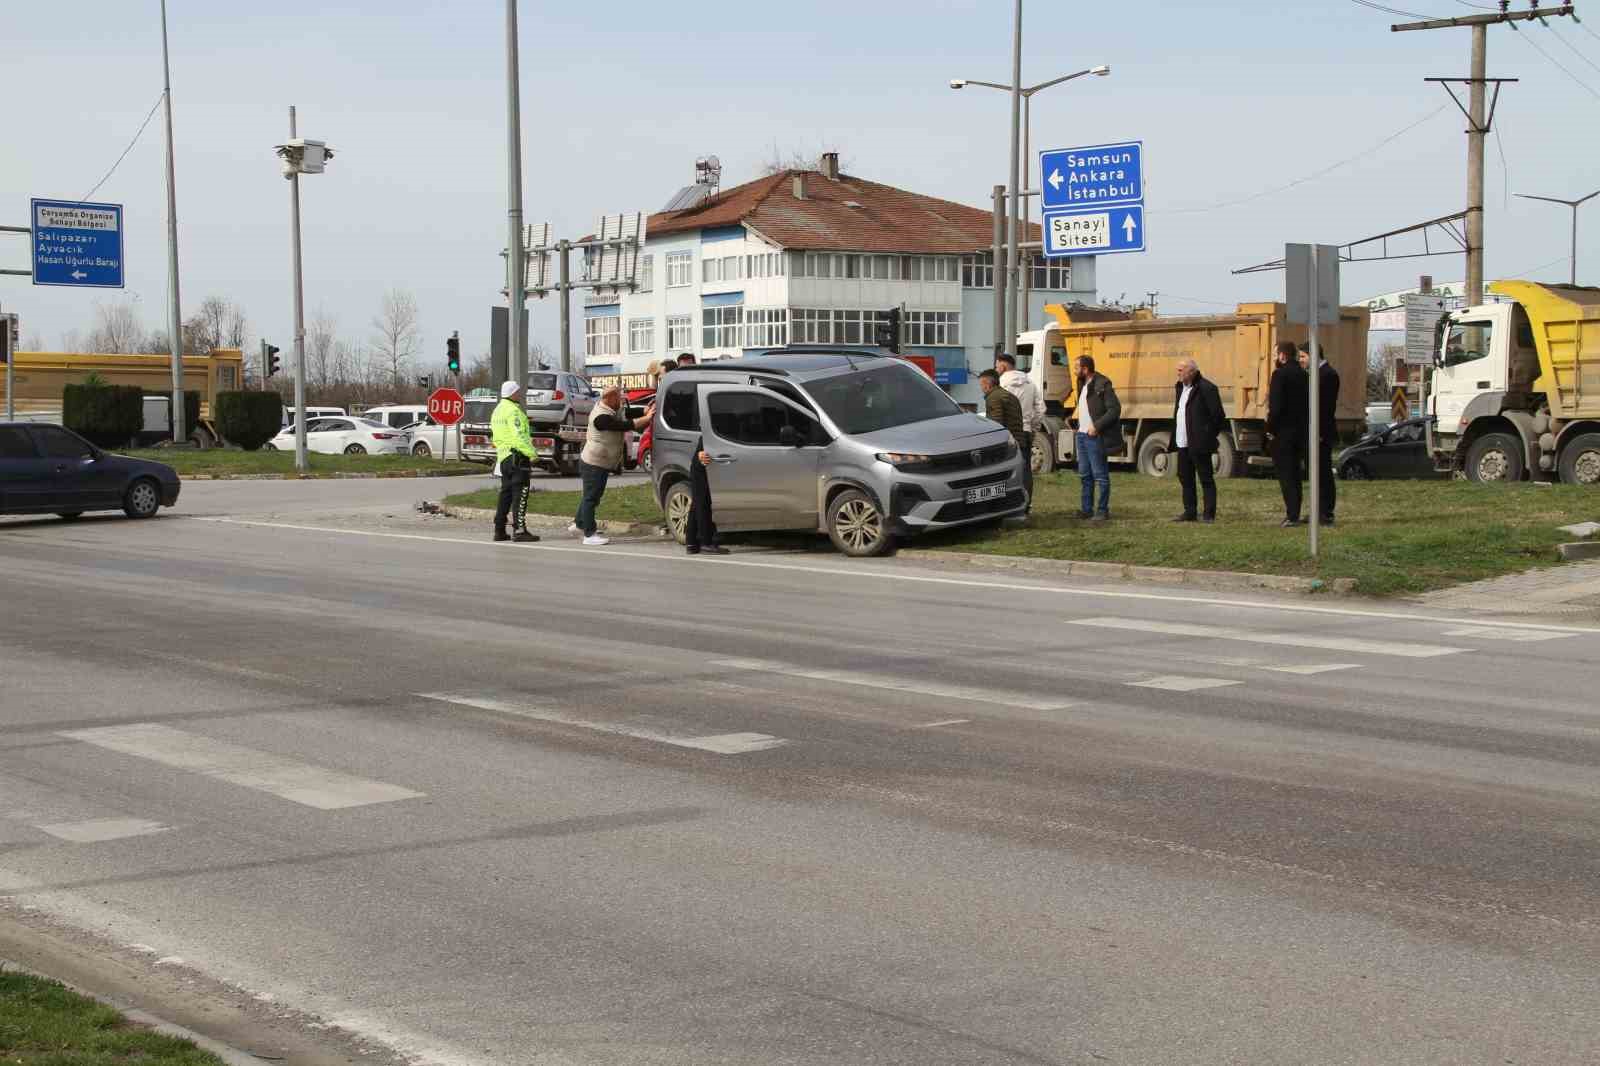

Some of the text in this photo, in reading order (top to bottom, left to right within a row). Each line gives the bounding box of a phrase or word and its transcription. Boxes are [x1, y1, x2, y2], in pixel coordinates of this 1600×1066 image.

[1067, 153, 1131, 168] Samsun
[1069, 169, 1125, 184] Ankara
[1068, 182, 1135, 200] İstanbul
[1054, 217, 1105, 232] Sanayi
[1059, 233, 1103, 247] Sitesi
[39, 243, 84, 254] Ayvacık
[38, 255, 64, 265] Hasan
[431, 399, 462, 416] DUR
